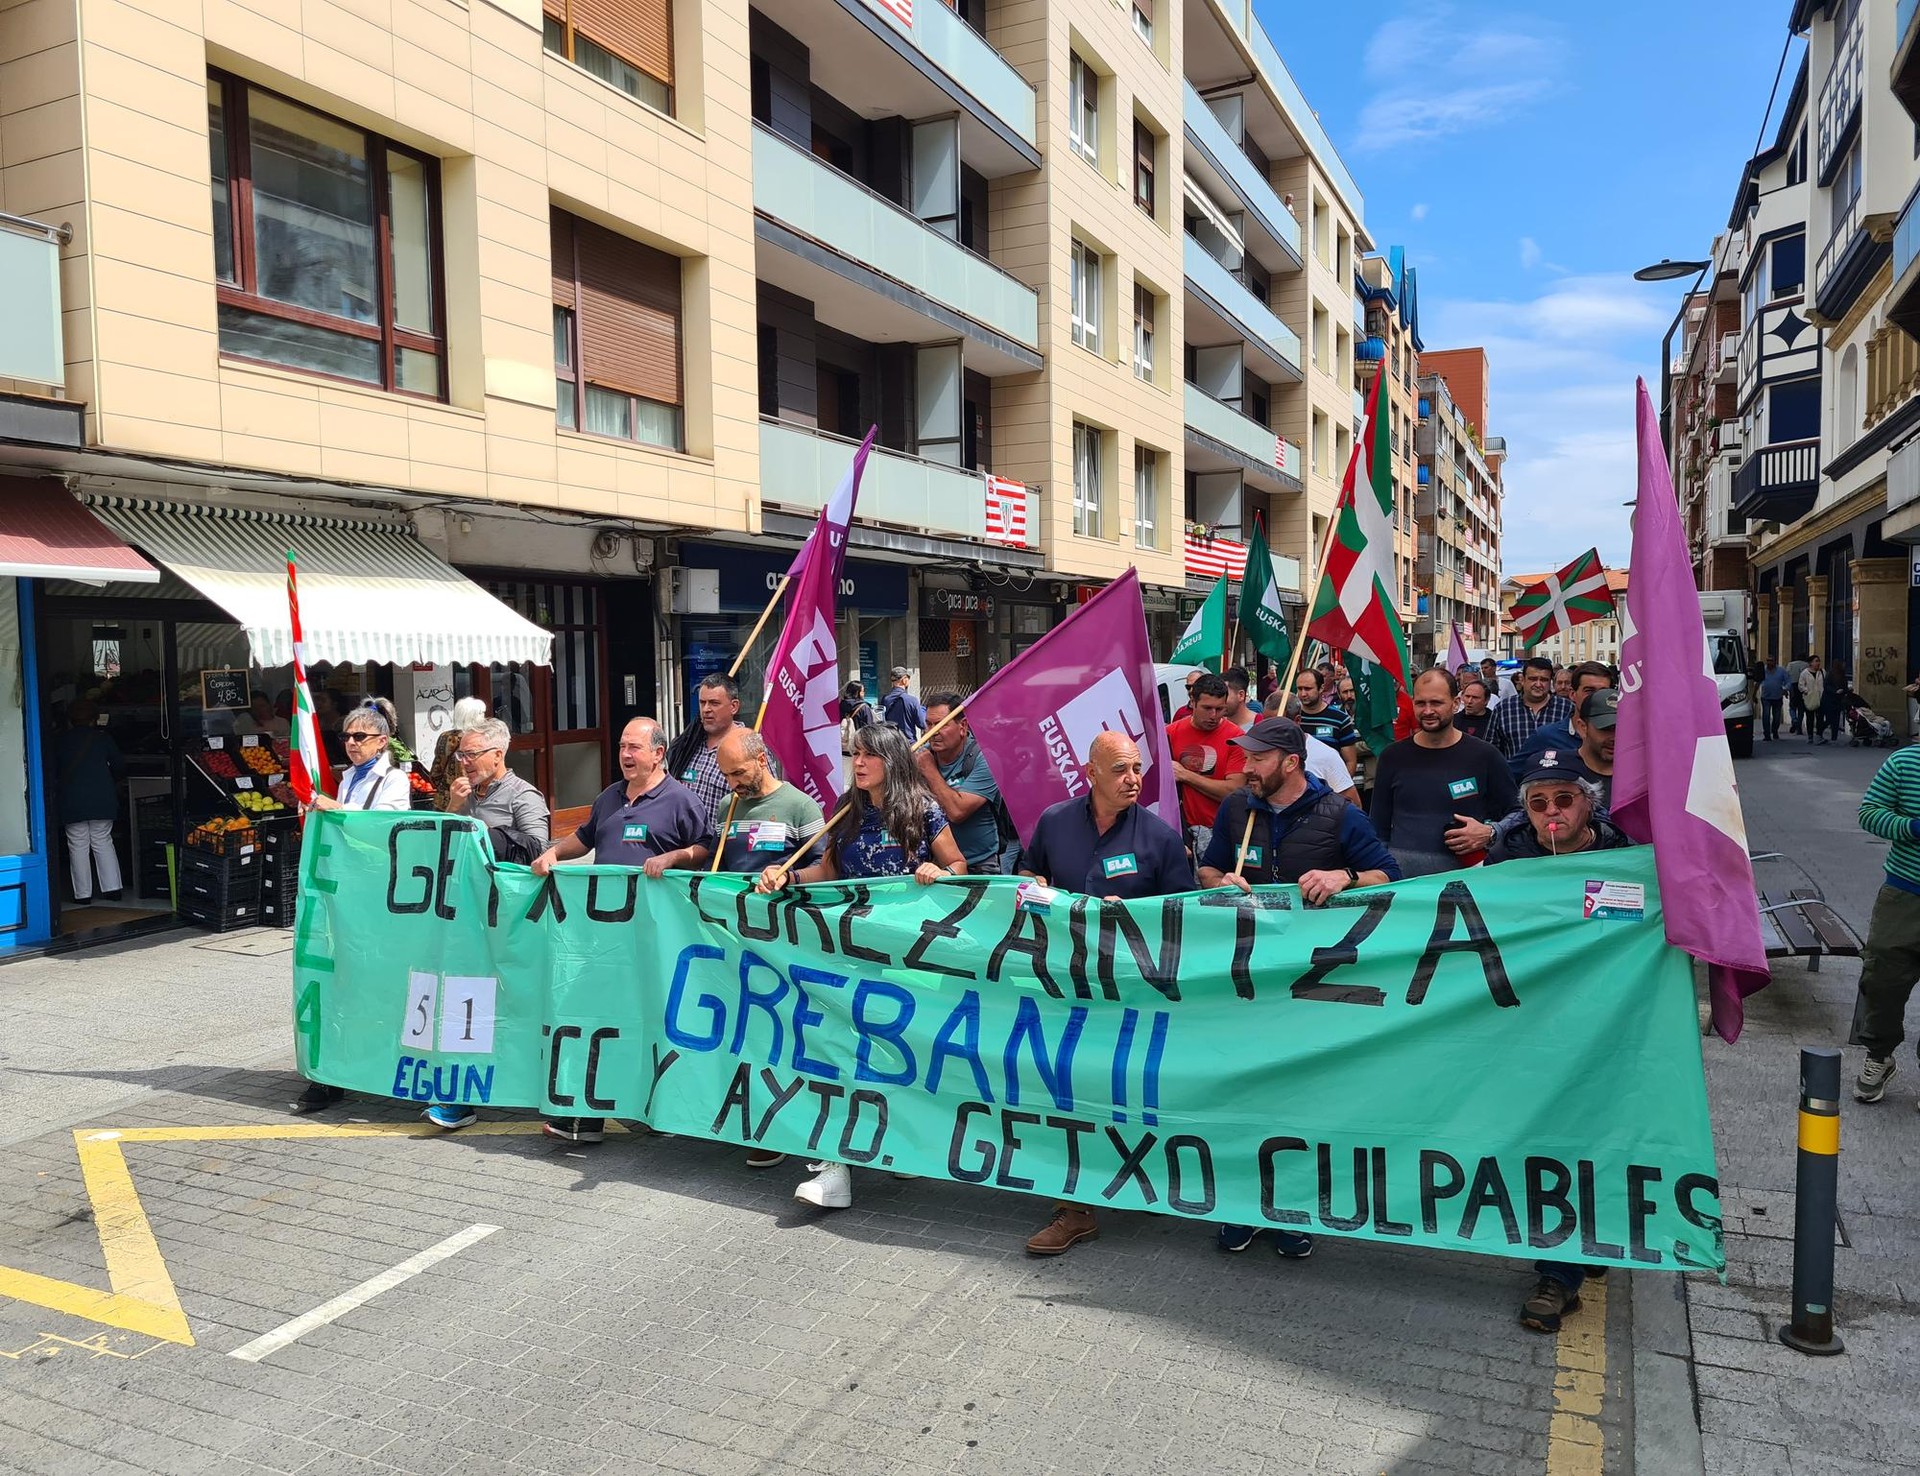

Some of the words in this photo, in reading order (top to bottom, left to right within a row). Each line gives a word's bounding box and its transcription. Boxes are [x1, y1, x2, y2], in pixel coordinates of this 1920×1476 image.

[1038, 715, 1084, 798] EUSKAL
[1452, 780, 1476, 795] ELA
[625, 827, 643, 837] ELA
[1107, 857, 1133, 872] ELA
[391, 1055, 495, 1104] EGUN
[644, 1042, 680, 1118] Y
[947, 1101, 1216, 1217] GETXO
[1257, 1135, 1723, 1270] CULPABLES
